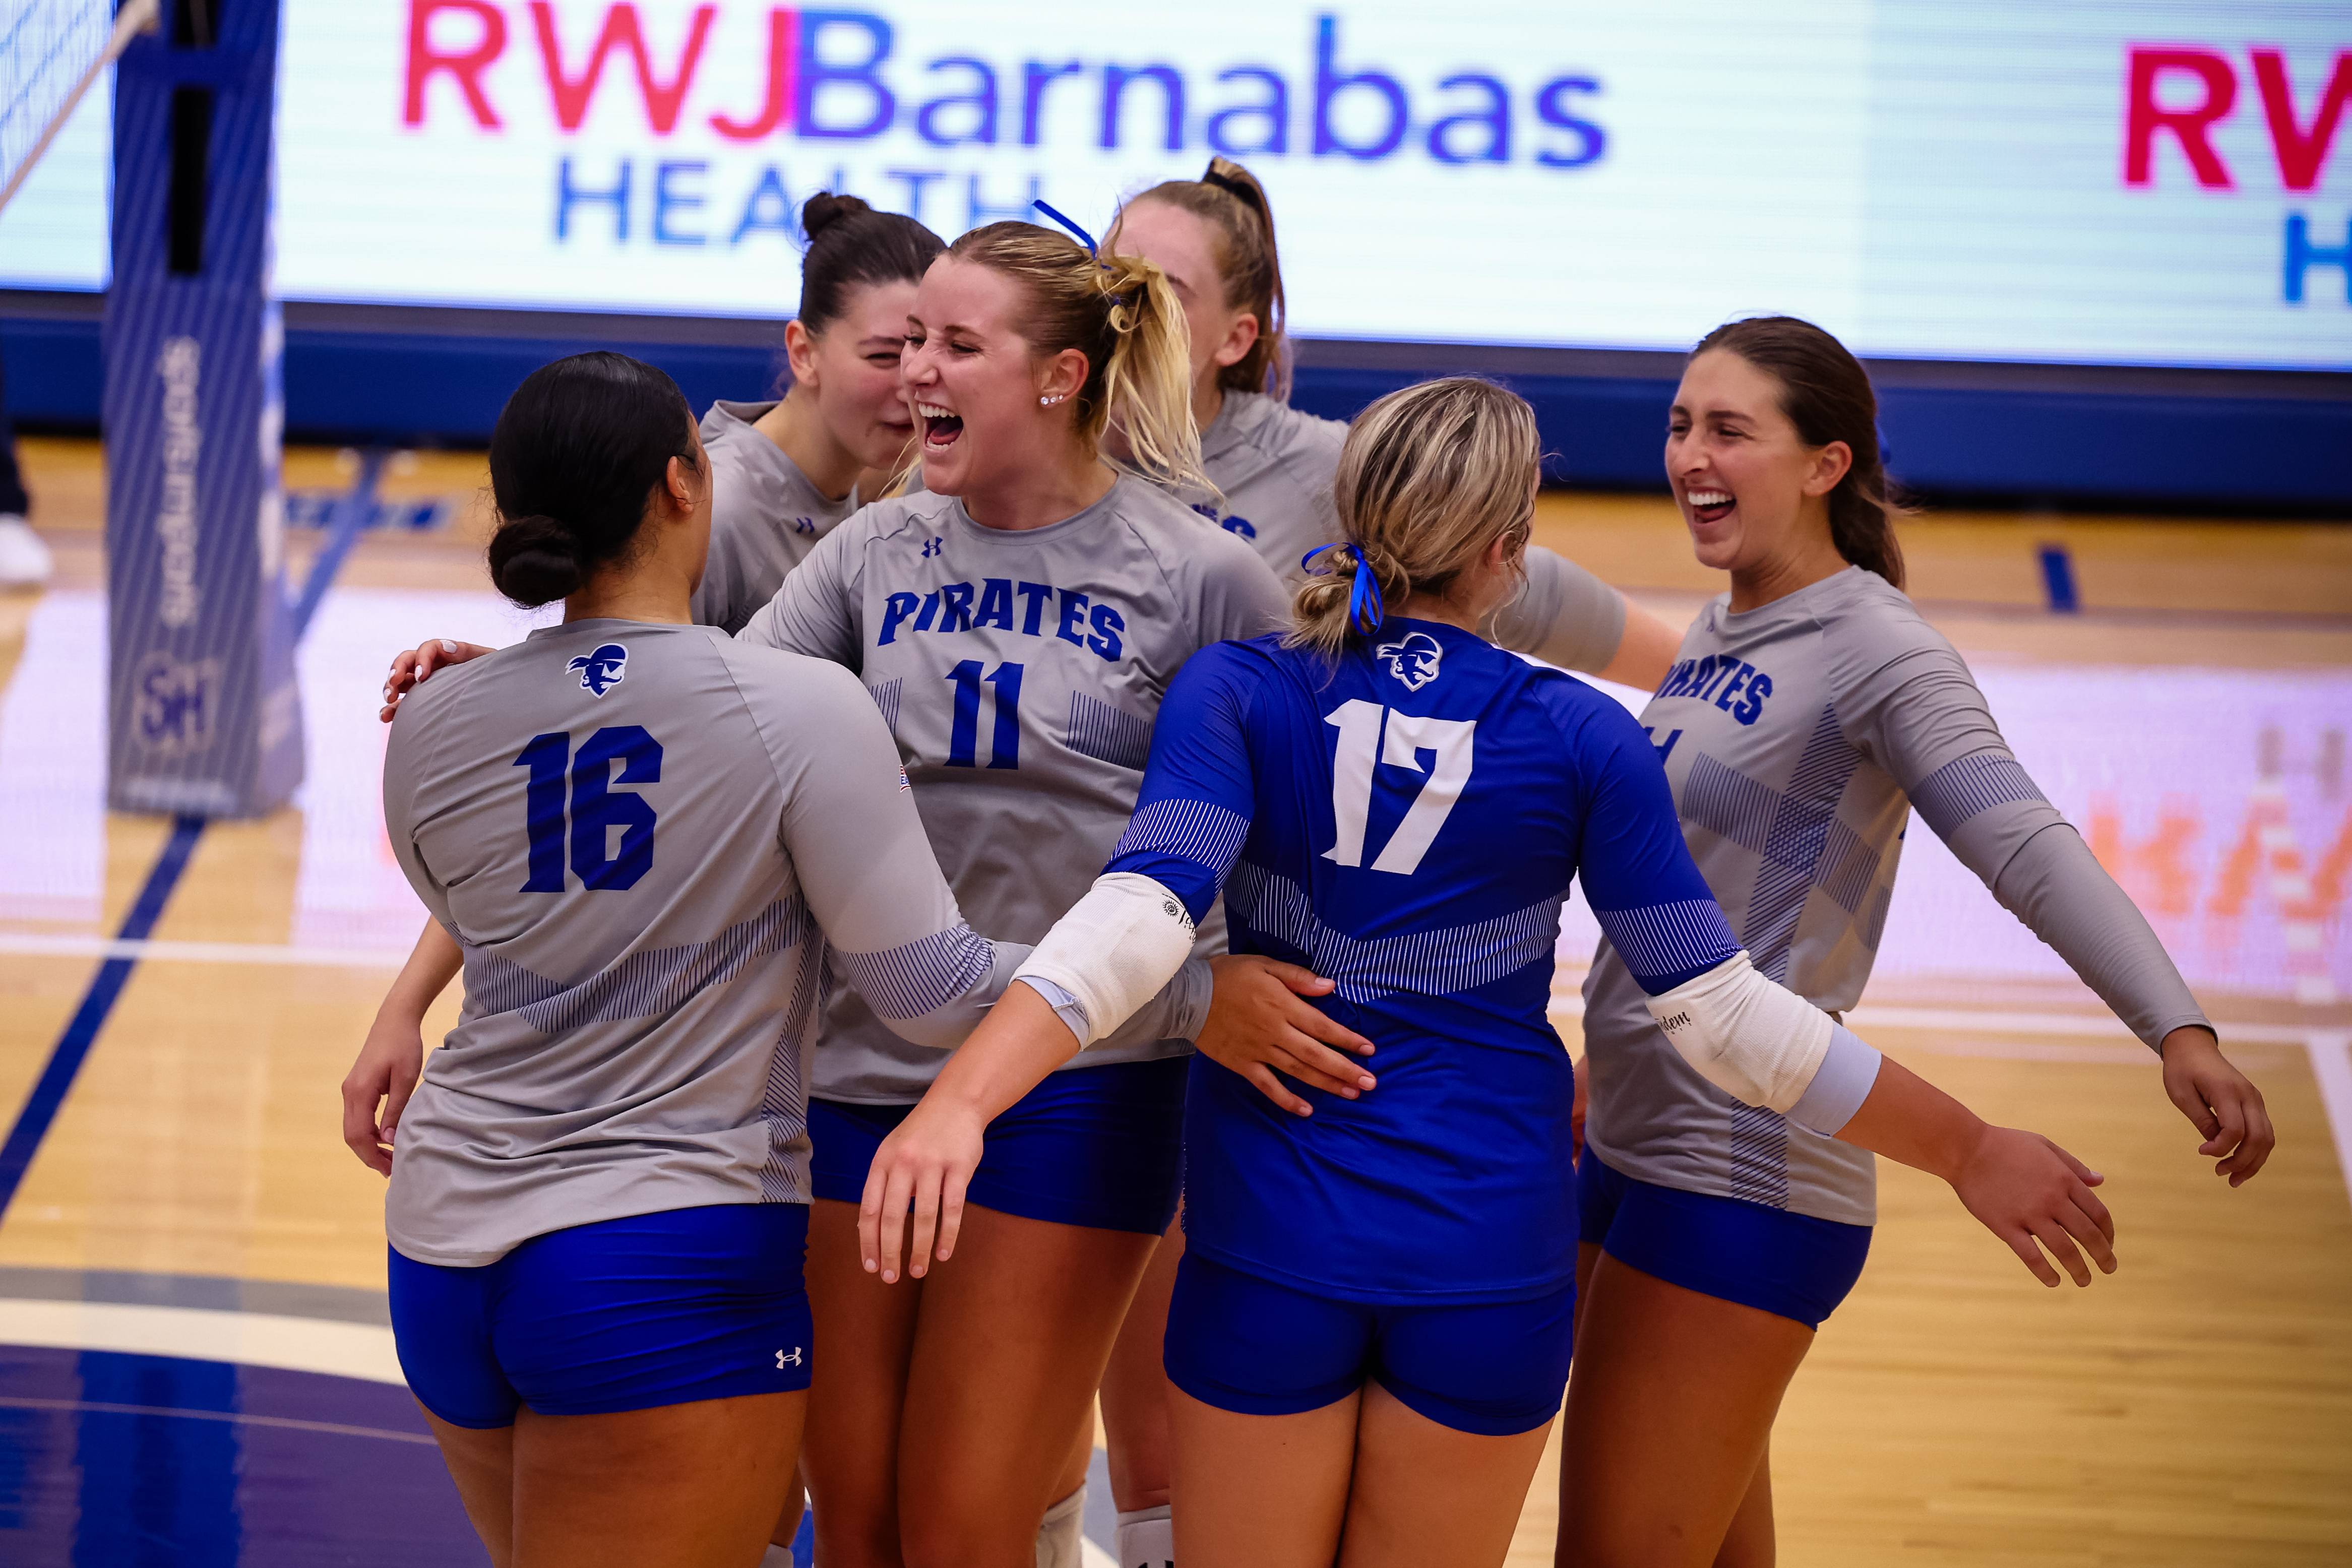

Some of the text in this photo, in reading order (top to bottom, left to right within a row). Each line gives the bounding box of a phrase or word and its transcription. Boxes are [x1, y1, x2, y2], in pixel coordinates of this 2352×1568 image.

[554, 158, 1039, 245] HEATH
[877, 578, 1125, 662] PIRATES
[944, 659, 1024, 770] 11
[512, 725, 664, 893] 16
[1320, 698, 1477, 875] 17
